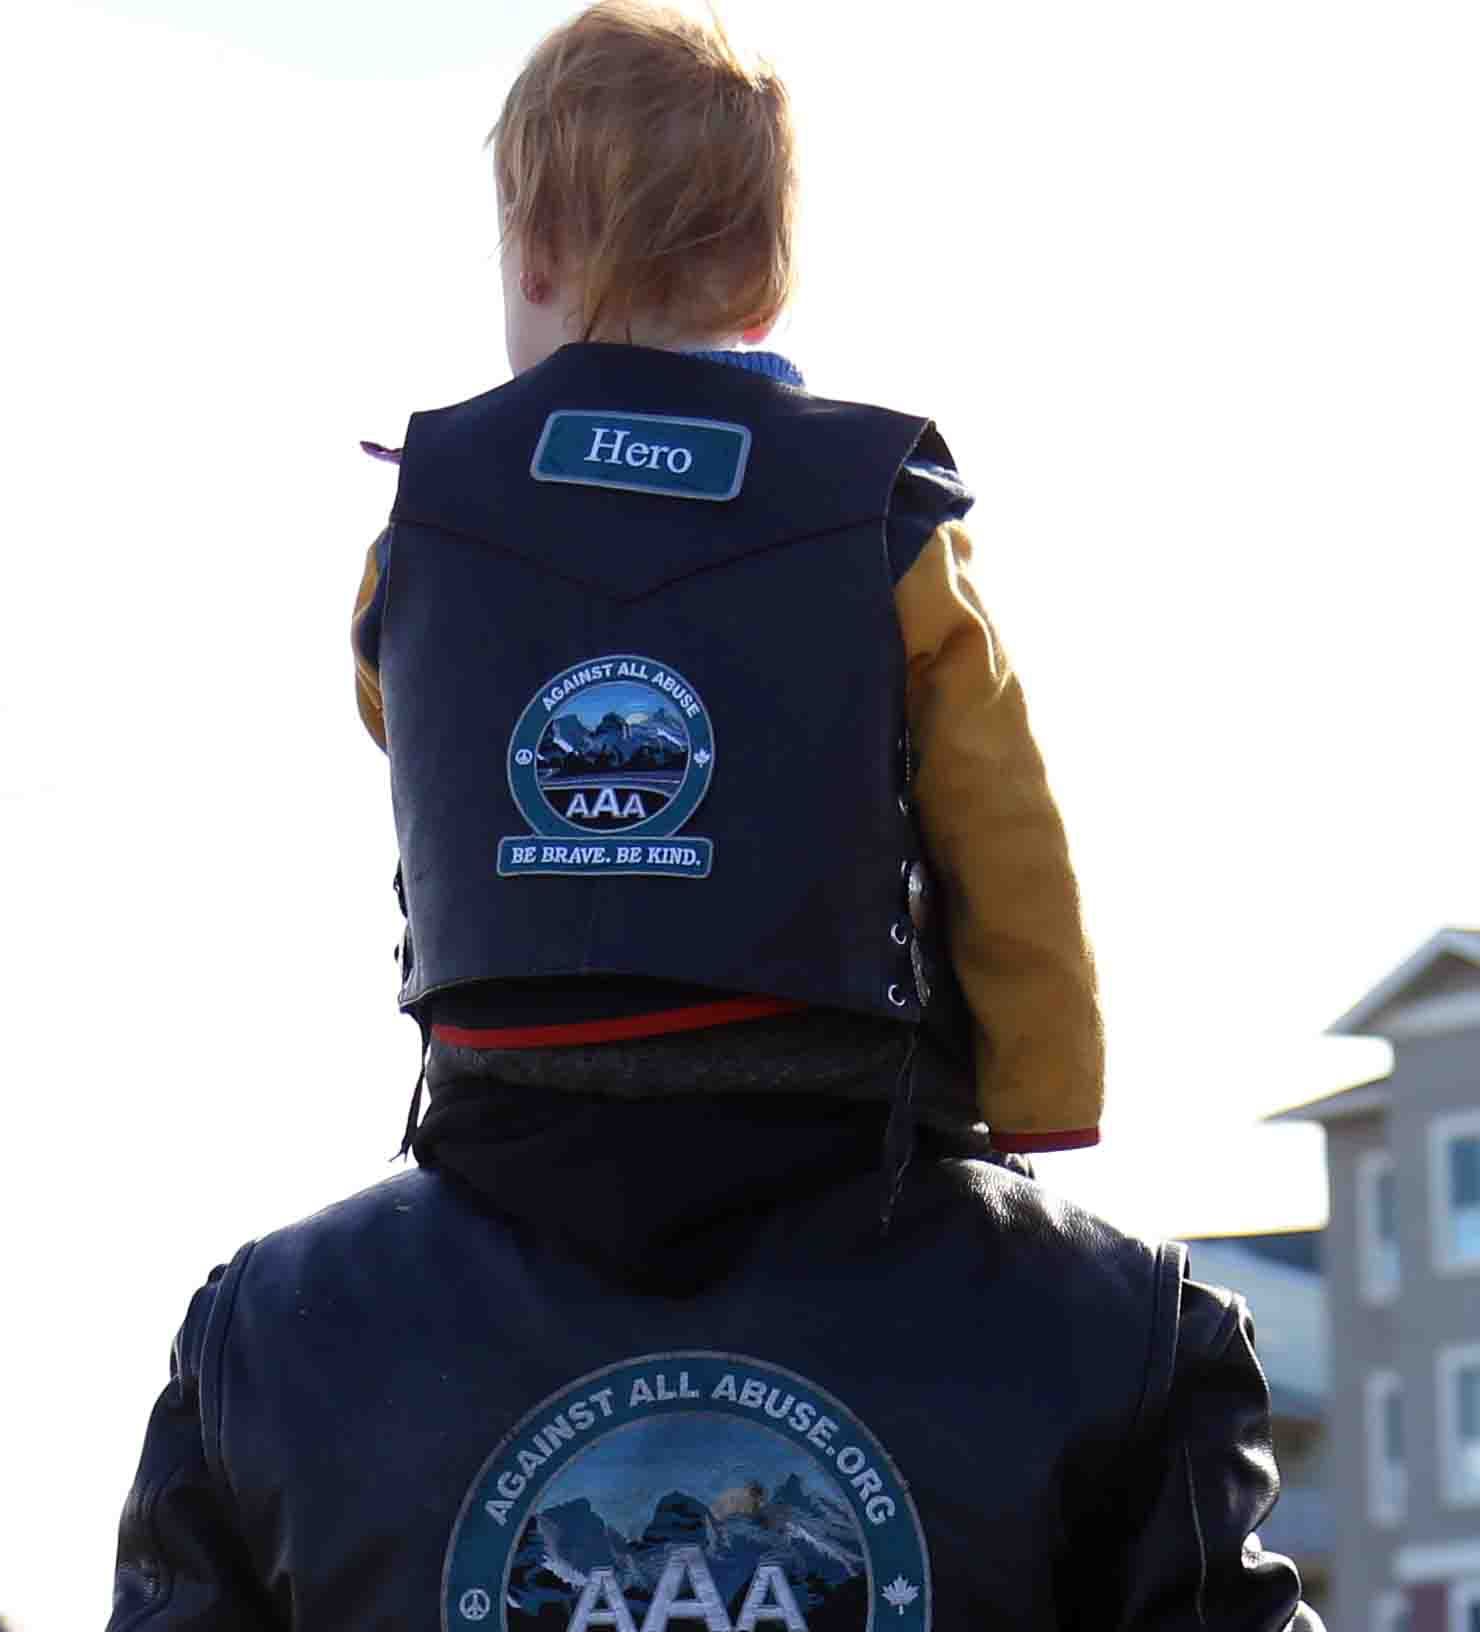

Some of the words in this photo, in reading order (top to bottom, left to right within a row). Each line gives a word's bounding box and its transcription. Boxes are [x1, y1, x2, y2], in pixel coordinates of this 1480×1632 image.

[583, 427, 693, 474] Hero
[541, 663, 613, 712] AGAINST
[617, 662, 649, 679] ALL
[651, 671, 701, 719] ABUSE
[566, 788, 647, 818] AAA
[511, 846, 537, 864] BE
[541, 846, 611, 864] BRAVE.
[616, 846, 642, 864] BE
[646, 847, 701, 866] KIND.
[484, 1387, 615, 1527] AGAINST
[629, 1370, 700, 1408] ALL
[712, 1373, 897, 1527] ABUSE.ORG
